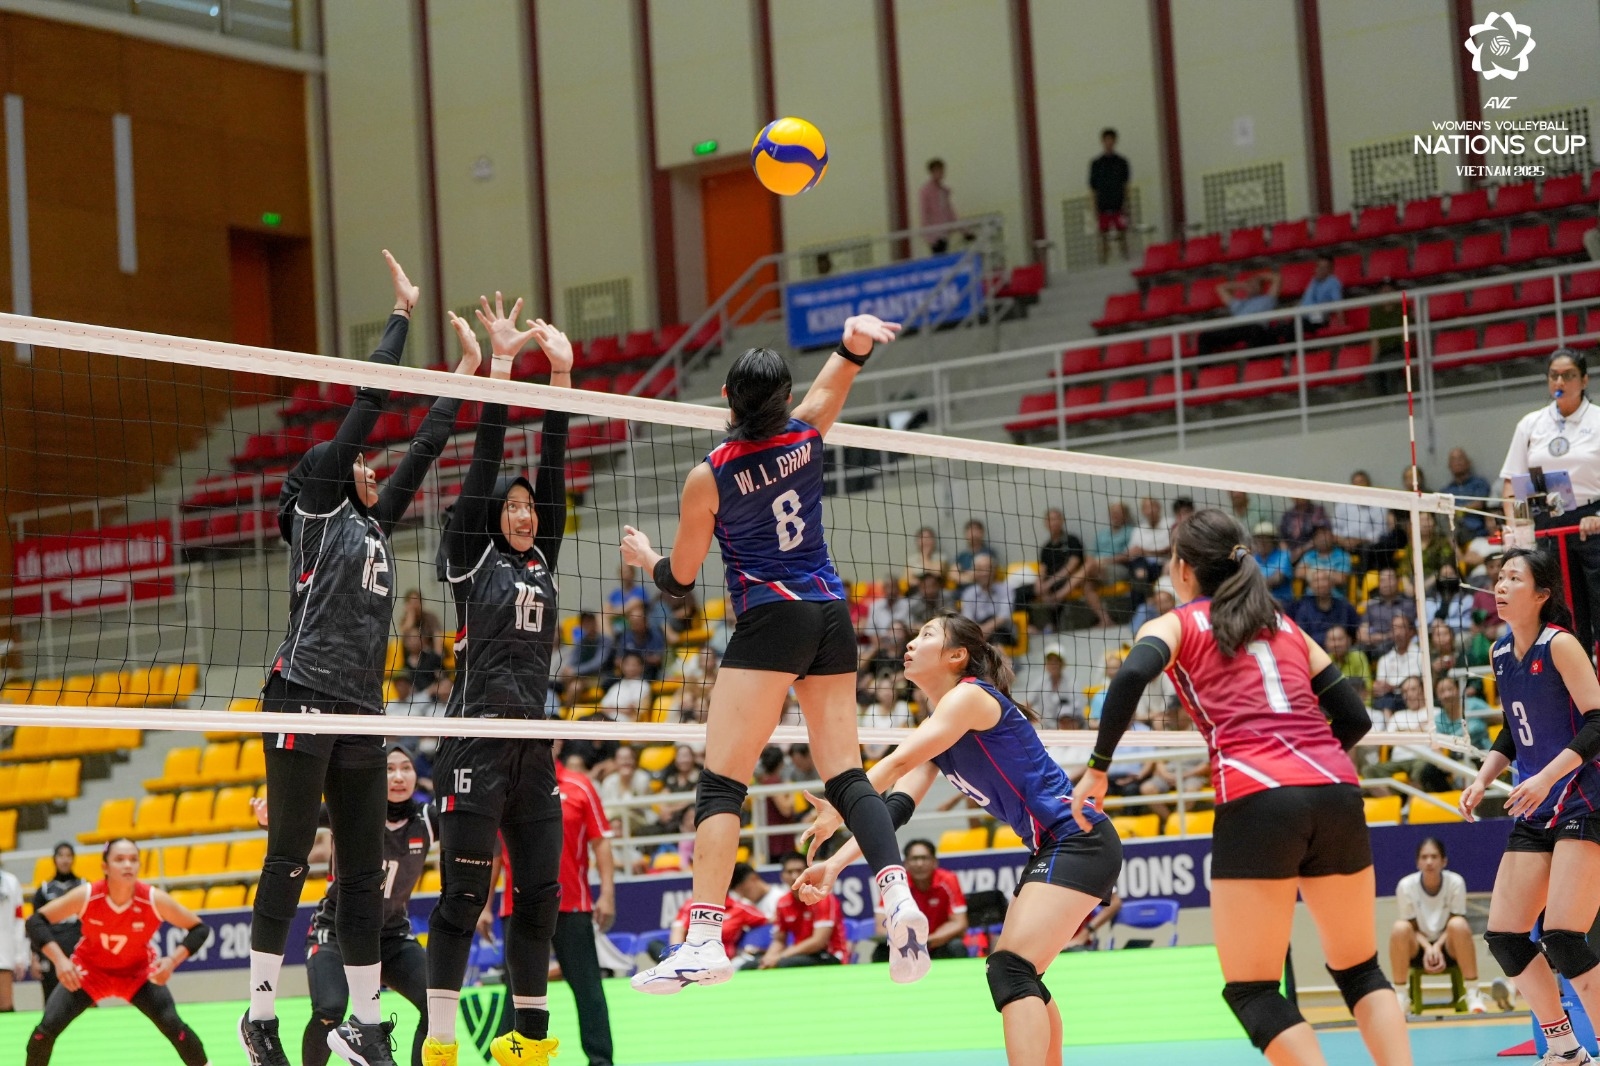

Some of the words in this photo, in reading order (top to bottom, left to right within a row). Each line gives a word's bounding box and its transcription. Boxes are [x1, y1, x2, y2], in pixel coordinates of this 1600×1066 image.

[733, 469, 760, 496] W.
[759, 463, 777, 486] L.
[776, 442, 812, 479] CHIM
[771, 489, 806, 552] 8
[361, 536, 389, 597] 12
[514, 581, 544, 633] 16
[1246, 640, 1293, 714] 1
[1511, 701, 1534, 747] 3
[453, 768, 473, 794] 16
[382, 859, 399, 899] 1
[1117, 853, 1196, 899] IONS
[691, 910, 723, 923] HKG
[100, 932, 128, 956] 17
